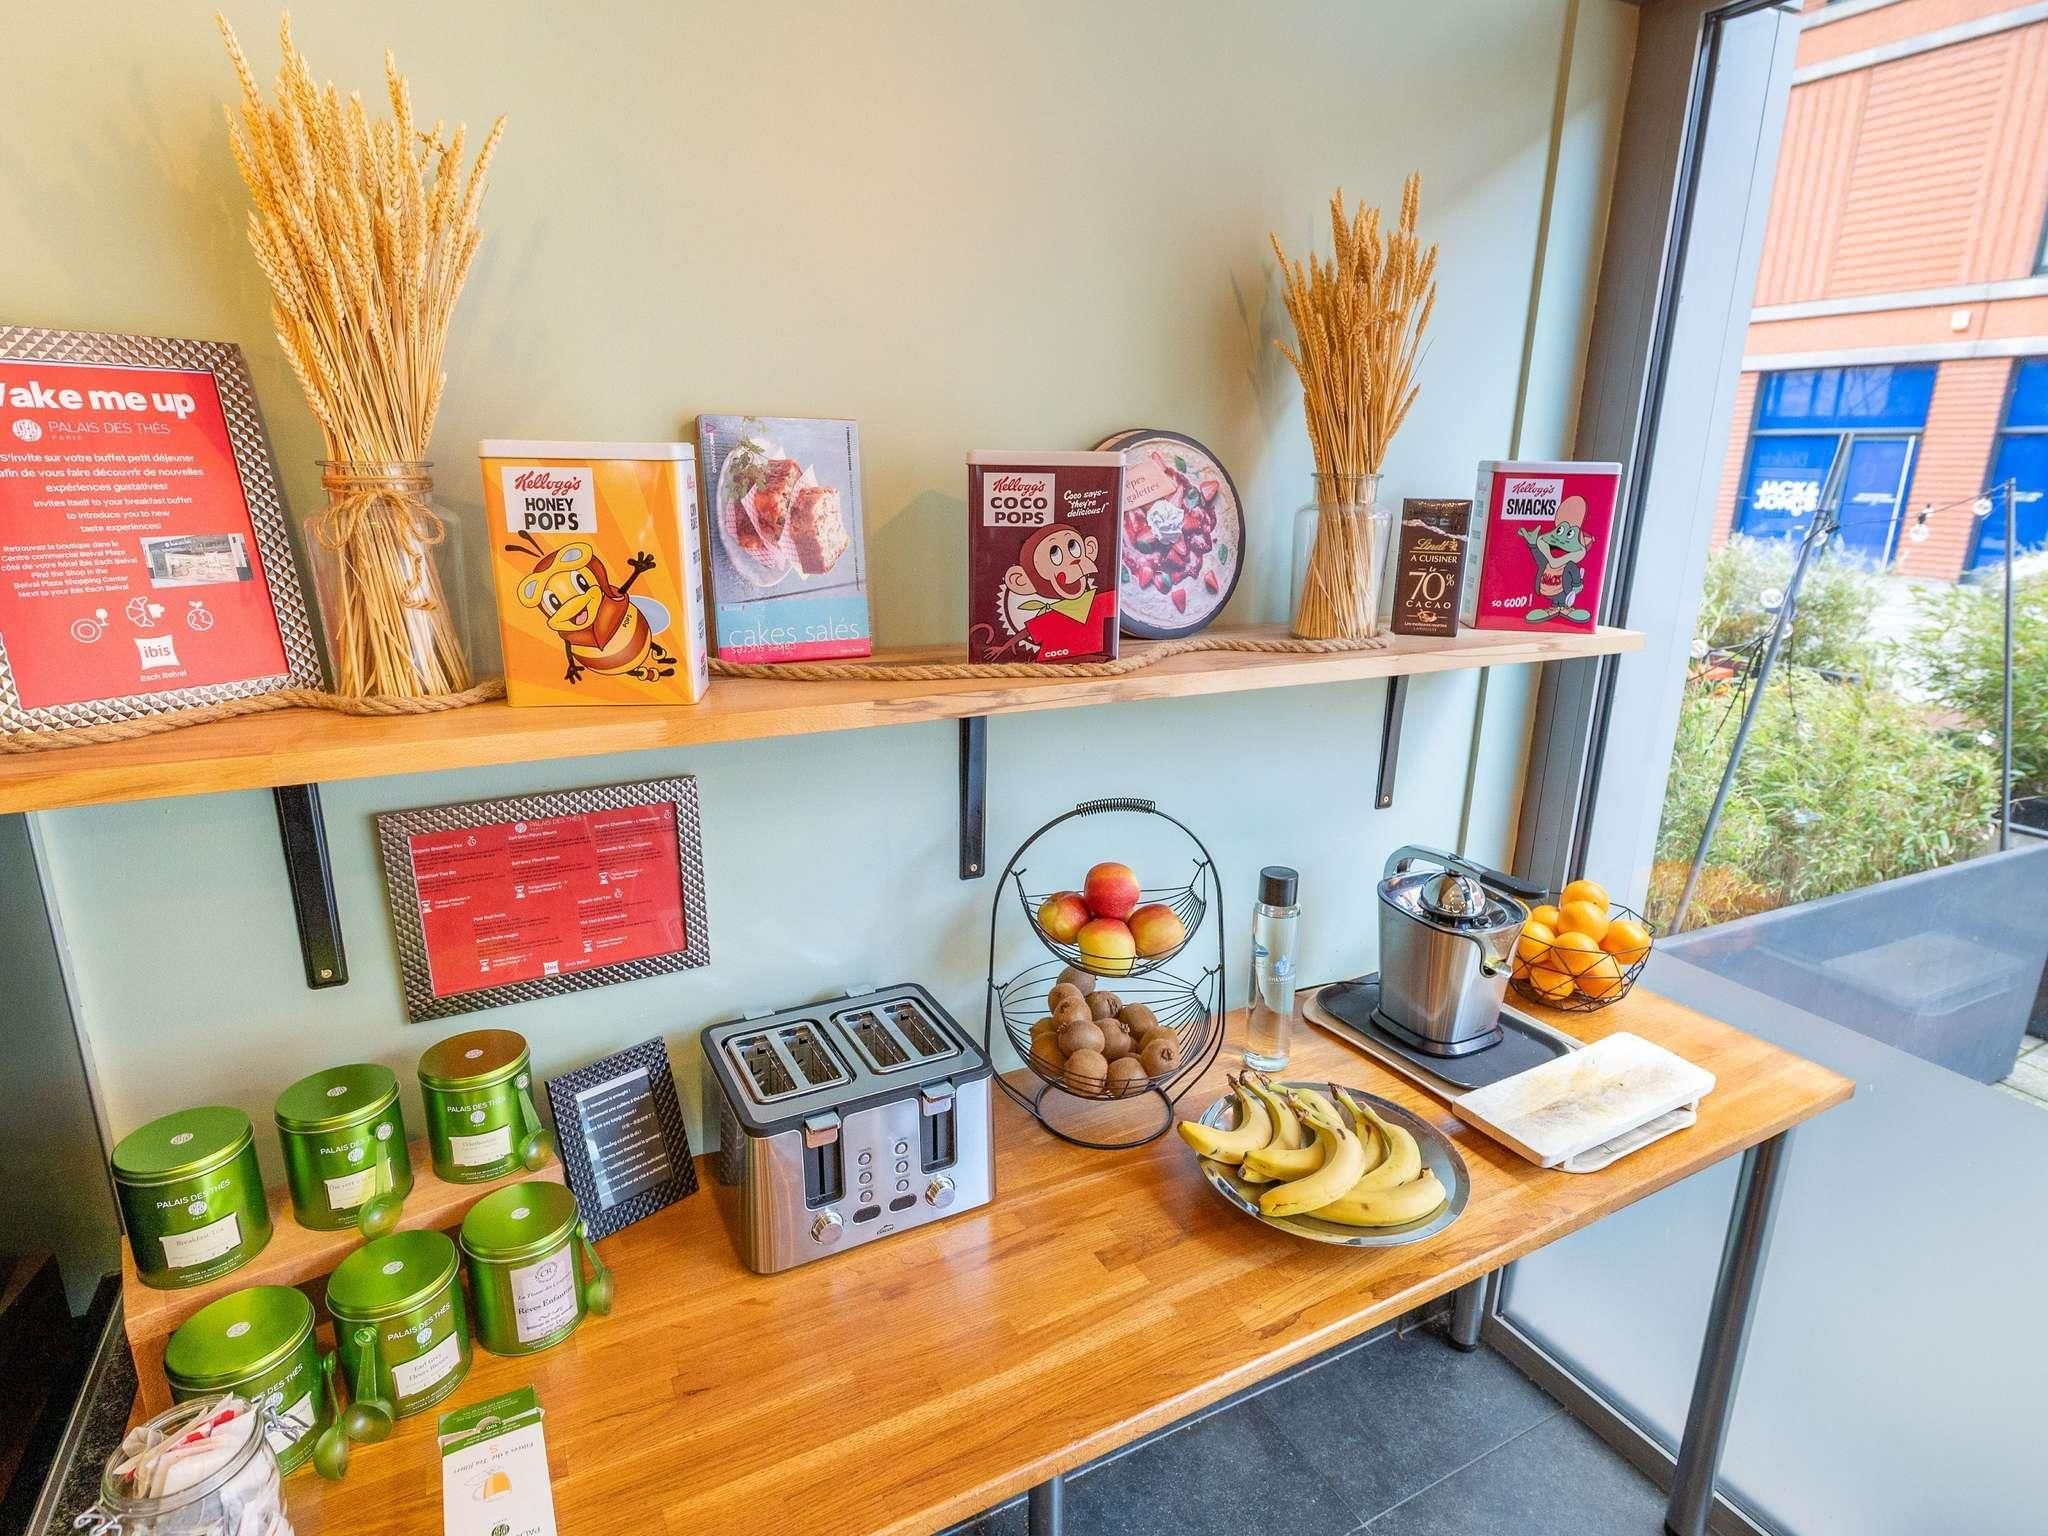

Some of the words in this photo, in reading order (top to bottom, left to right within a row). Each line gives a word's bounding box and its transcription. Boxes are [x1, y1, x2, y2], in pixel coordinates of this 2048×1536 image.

[0, 381, 84, 410] ake
[88, 390, 148, 412] me
[152, 392, 196, 419] up
[48, 421, 100, 434] PALAIS
[104, 422, 132, 434] DES
[136, 420, 170, 436] THÉS
[0, 452, 42, 463] S'invite
[44, 454, 61, 463] sur
[63, 454, 93, 463] votre
[94, 453, 125, 463] buffet
[127, 453, 151, 464] petit
[152, 452, 194, 464] déjeuner
[21, 467, 37, 478] de
[39, 469, 65, 478] vous
[66, 467, 91, 478] faire
[92, 466, 142, 478] découvrir
[143, 467, 157, 477] de
[158, 466, 204, 477] nouvelles
[45, 483, 113, 494] expériences
[515, 471, 582, 496] Kellogg's
[993, 476, 1046, 497] Kellogg's
[1512, 481, 1555, 497] Kellogg's
[1063, 489, 1082, 501] Coco
[91, 499, 102, 507] to
[102, 499, 123, 509] your
[123, 497, 166, 507] breakfast
[166, 496, 193, 506] buffet
[525, 497, 574, 512] HONEY
[990, 497, 1048, 510] COCO
[1506, 498, 1557, 516] SMACKS
[66, 512, 77, 520] to
[78, 511, 121, 520] introduce
[122, 512, 140, 521] you
[140, 511, 151, 519] to
[524, 512, 579, 530] POPS
[994, 511, 1045, 525] POPS
[1413, 538, 1451, 551] Lindt
[1419, 554, 1458, 564] CUISINER
[1406, 600, 1452, 609] CACAO
[1503, 596, 1528, 608] GOOD
[729, 620, 798, 648] cakes
[806, 616, 860, 641] salés
[143, 644, 171, 659] ibis
[1044, 648, 1070, 658] COCO
[140, 671, 161, 682] Esch
[161, 669, 187, 680] Belval
[447, 1105, 472, 1113] PALAIS
[320, 1143, 349, 1156] PALAIS
[156, 1196, 189, 1209] PALAIS
[387, 1325, 418, 1341] PALAIS
[419, 1315, 434, 1330] DES
[267, 1379, 286, 1395] DES
